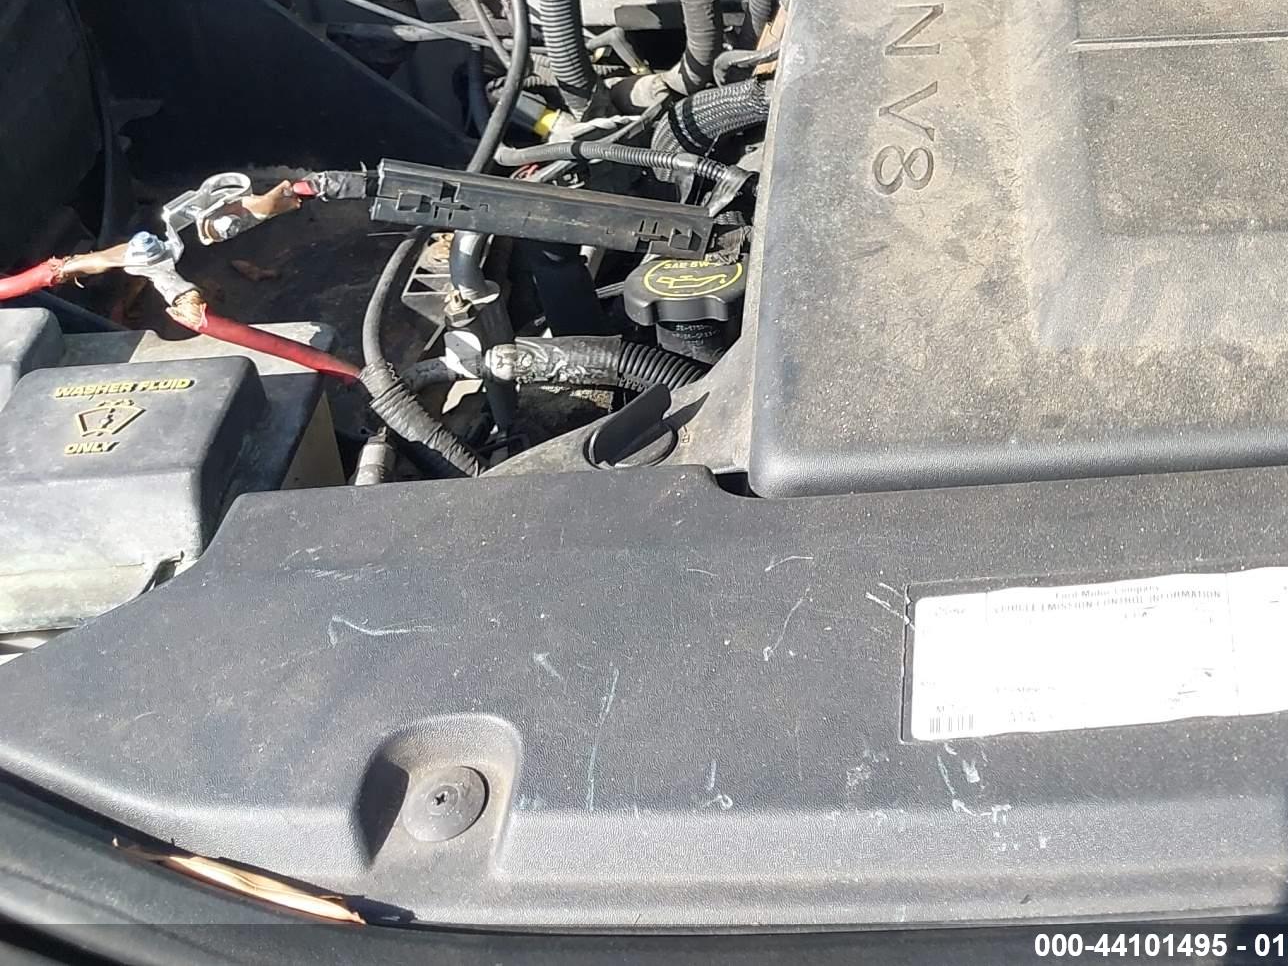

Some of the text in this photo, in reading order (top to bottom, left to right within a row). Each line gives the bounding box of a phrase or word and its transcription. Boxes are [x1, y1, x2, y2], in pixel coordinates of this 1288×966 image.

[872, 80, 938, 195] V8
[54, 378, 195, 399] WASHER FLUID
[64, 441, 119, 455] ONLY
